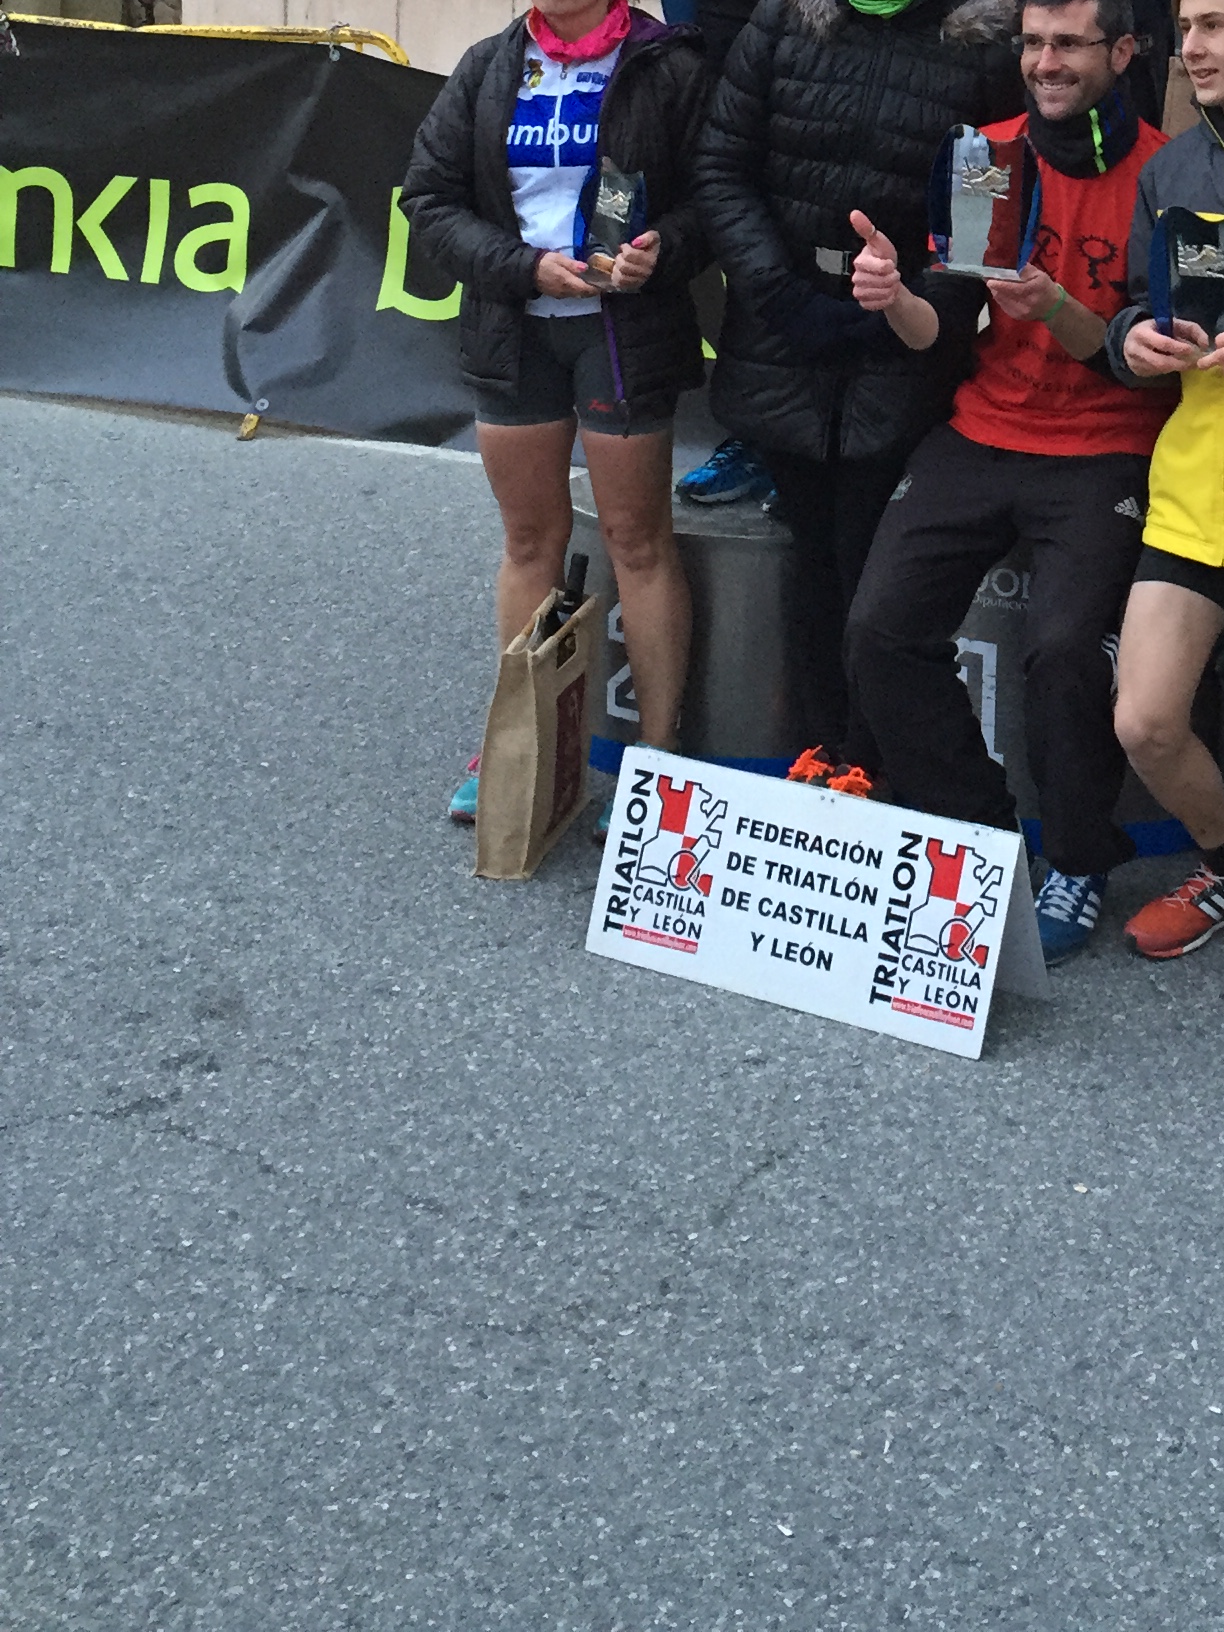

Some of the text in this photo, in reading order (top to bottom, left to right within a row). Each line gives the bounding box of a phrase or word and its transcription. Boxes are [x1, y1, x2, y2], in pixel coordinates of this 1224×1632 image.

[603, 768, 655, 932] TRIATLON
[735, 815, 883, 869] FEDERACIÓN
[633, 884, 705, 917] CASTILLA
[726, 850, 878, 906] DE TRIATLÓN
[629, 905, 641, 923] Y
[653, 912, 702, 940] LEÓN
[720, 886, 868, 943] DE CASTILLA
[869, 830, 923, 1004] TRIATLON
[750, 930, 833, 972] Y LEÓN
[901, 954, 981, 990] CASTILLA
[898, 976, 911, 995] Y
[924, 983, 978, 1014] LEÓN
